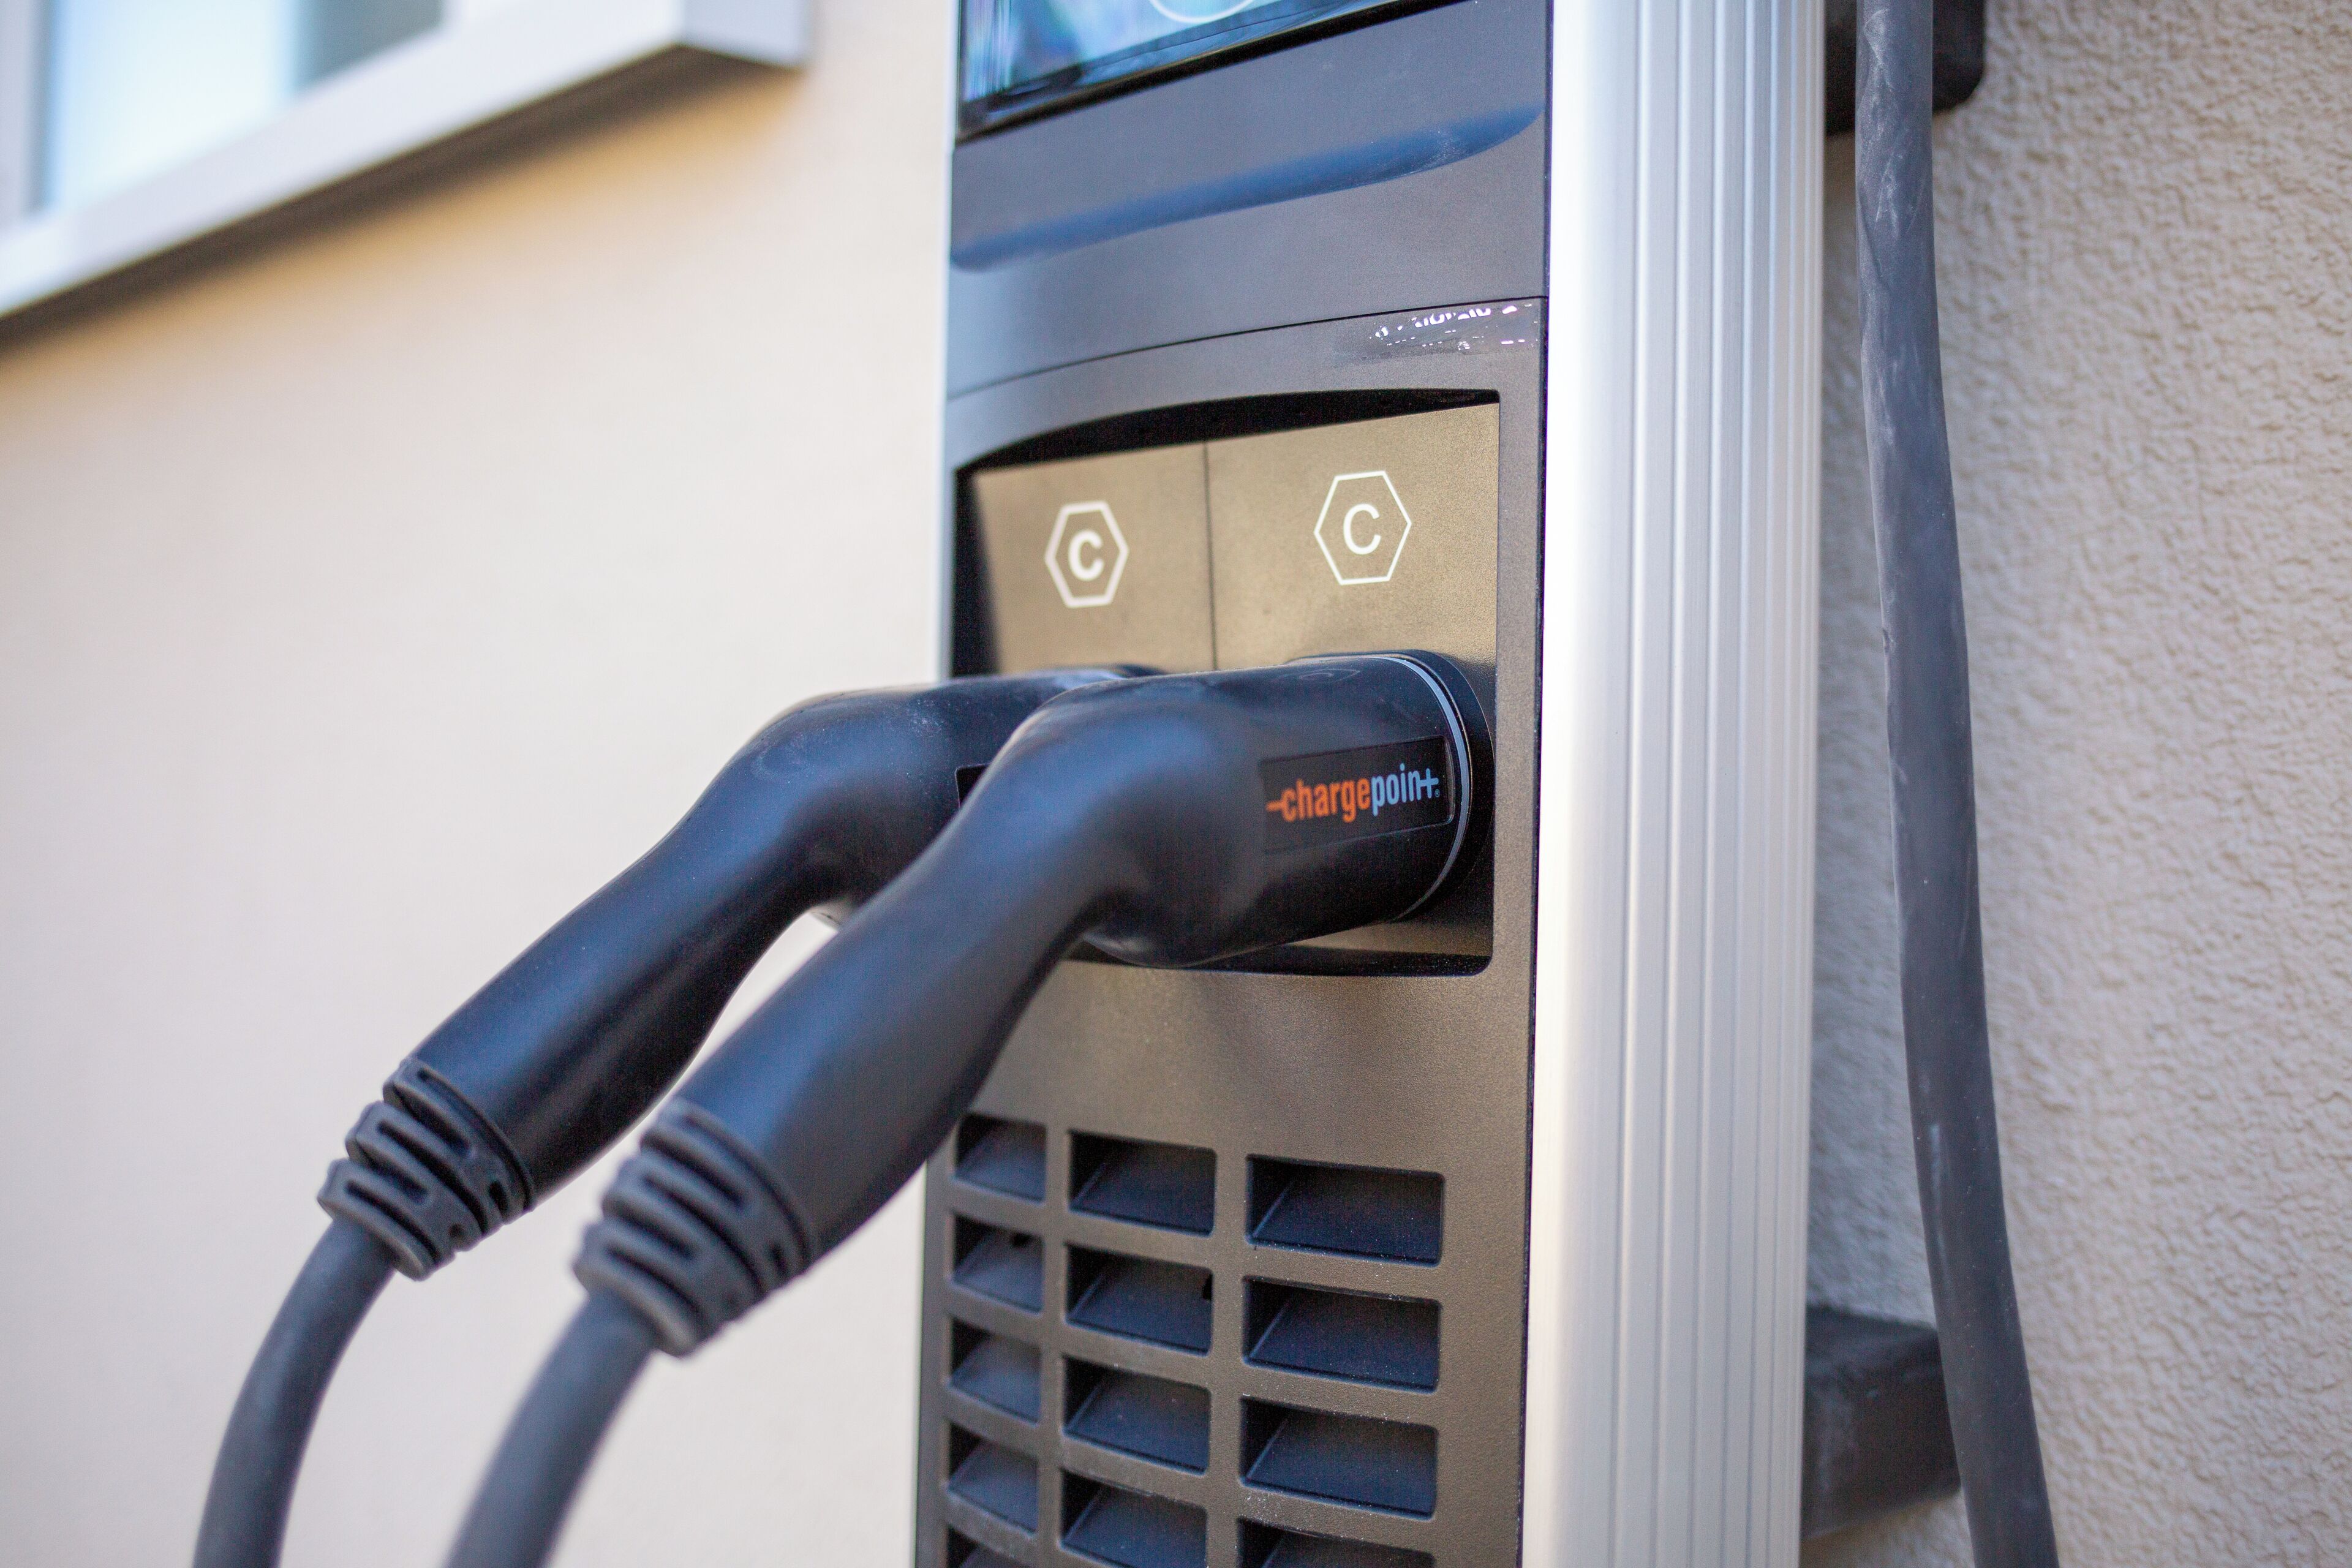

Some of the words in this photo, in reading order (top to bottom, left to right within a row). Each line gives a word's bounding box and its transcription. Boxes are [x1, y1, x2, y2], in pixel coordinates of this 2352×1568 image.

[1343, 503, 1382, 555] C
[1068, 530, 1104, 581] C
[1266, 763, 1439, 823] chargepoint
